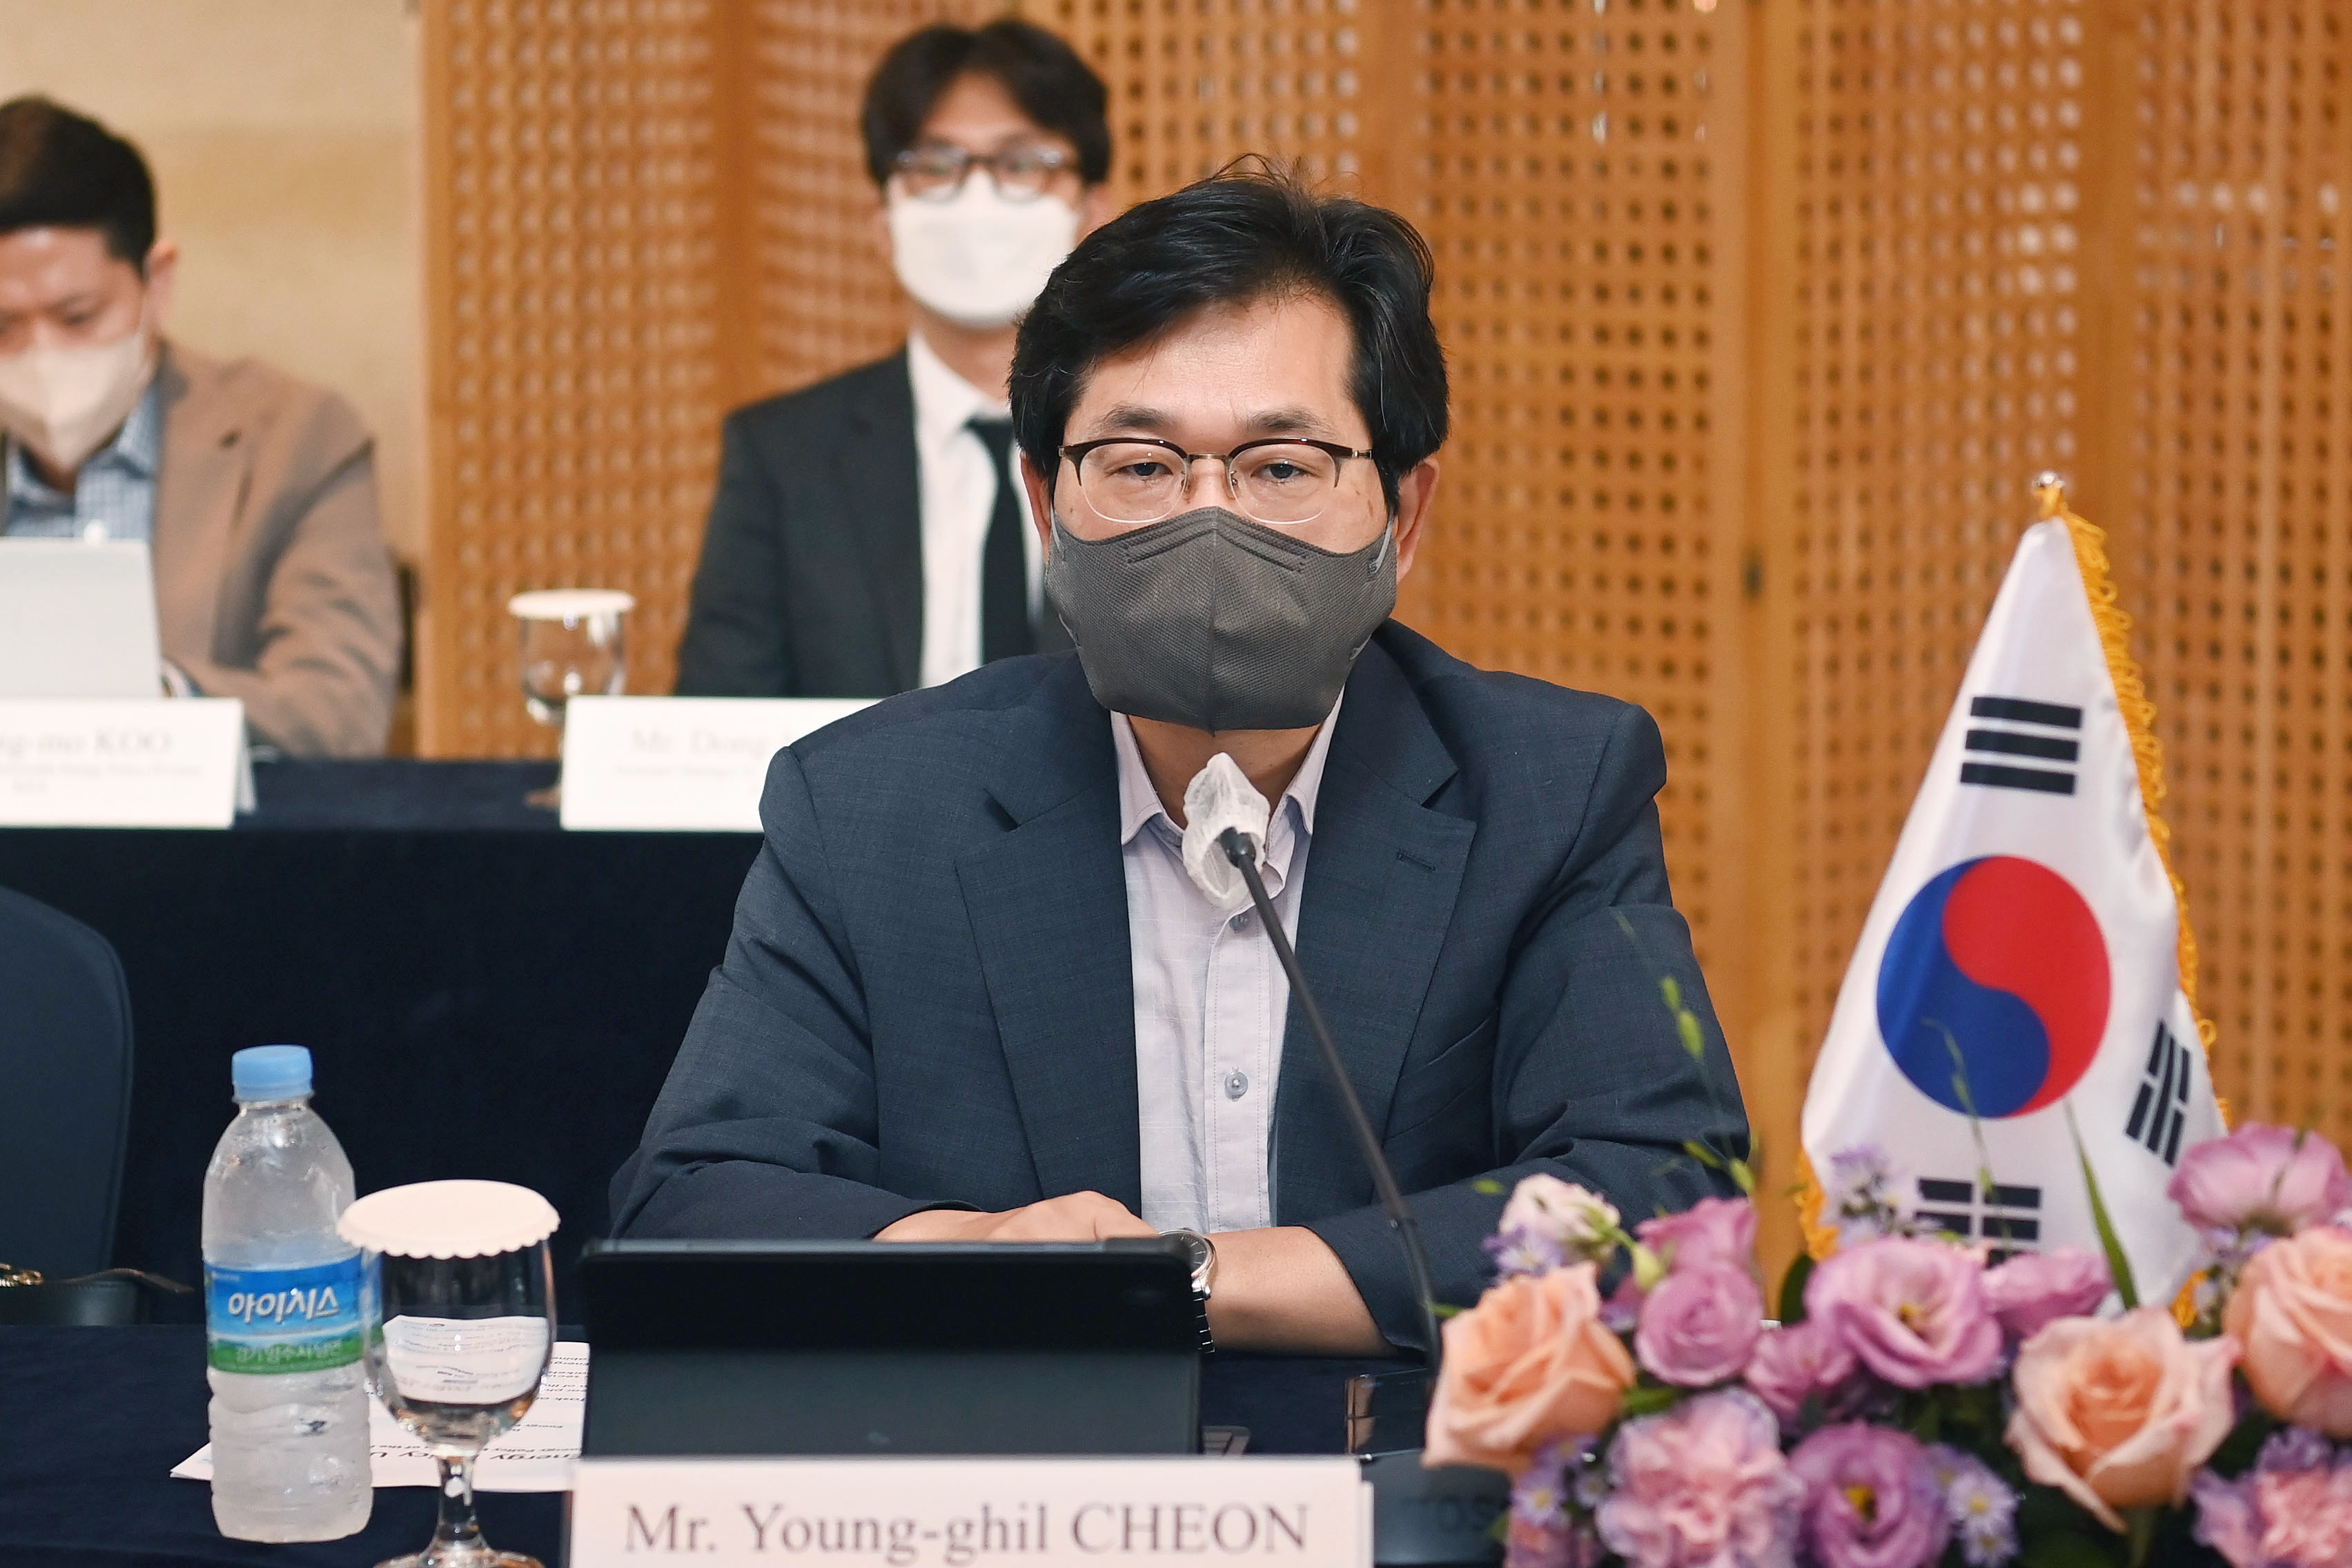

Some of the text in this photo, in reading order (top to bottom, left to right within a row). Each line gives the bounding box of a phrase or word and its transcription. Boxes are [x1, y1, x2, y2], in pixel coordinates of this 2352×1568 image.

[95, 728, 174, 753] KOO
[228, 1286, 340, 1324] 아이시스
[623, 1500, 1310, 1567] Mr. Young-ghil CHEON
